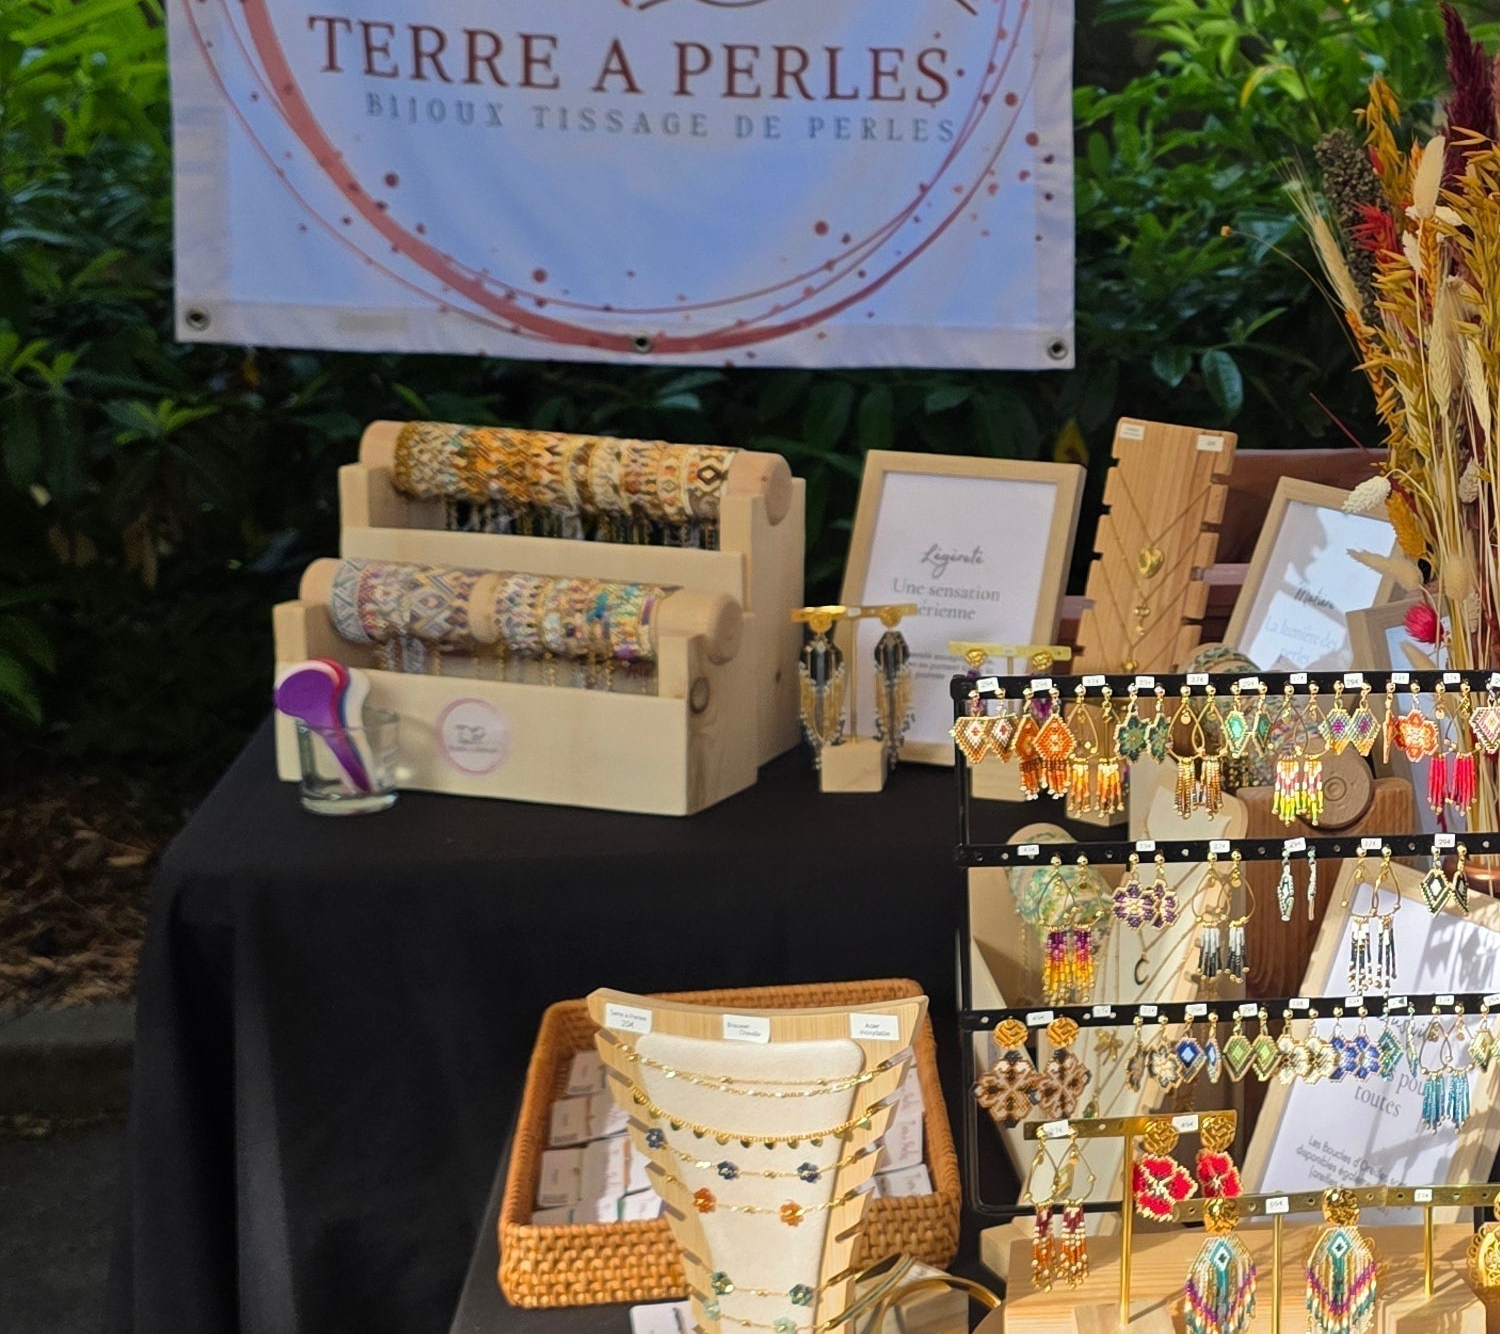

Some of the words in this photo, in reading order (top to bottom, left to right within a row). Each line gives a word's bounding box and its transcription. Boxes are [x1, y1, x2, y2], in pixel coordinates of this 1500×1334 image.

[307, 15, 561, 89] TERRE
[591, 37, 644, 96] A
[671, 43, 951, 103] PERLES
[364, 89, 504, 128] BIJOUX
[532, 103, 710, 139] TISSAGE
[735, 113, 782, 140] DE
[807, 114, 956, 143] PERLES
[893, 577, 925, 594] Une
[929, 585, 1000, 602] sensation
[1354, 1085, 1402, 1117] toutes
[1296, 1145, 1337, 1173] disponibles
[1309, 1135, 1321, 1149] Les
[1322, 1141, 1352, 1164] Boucles
